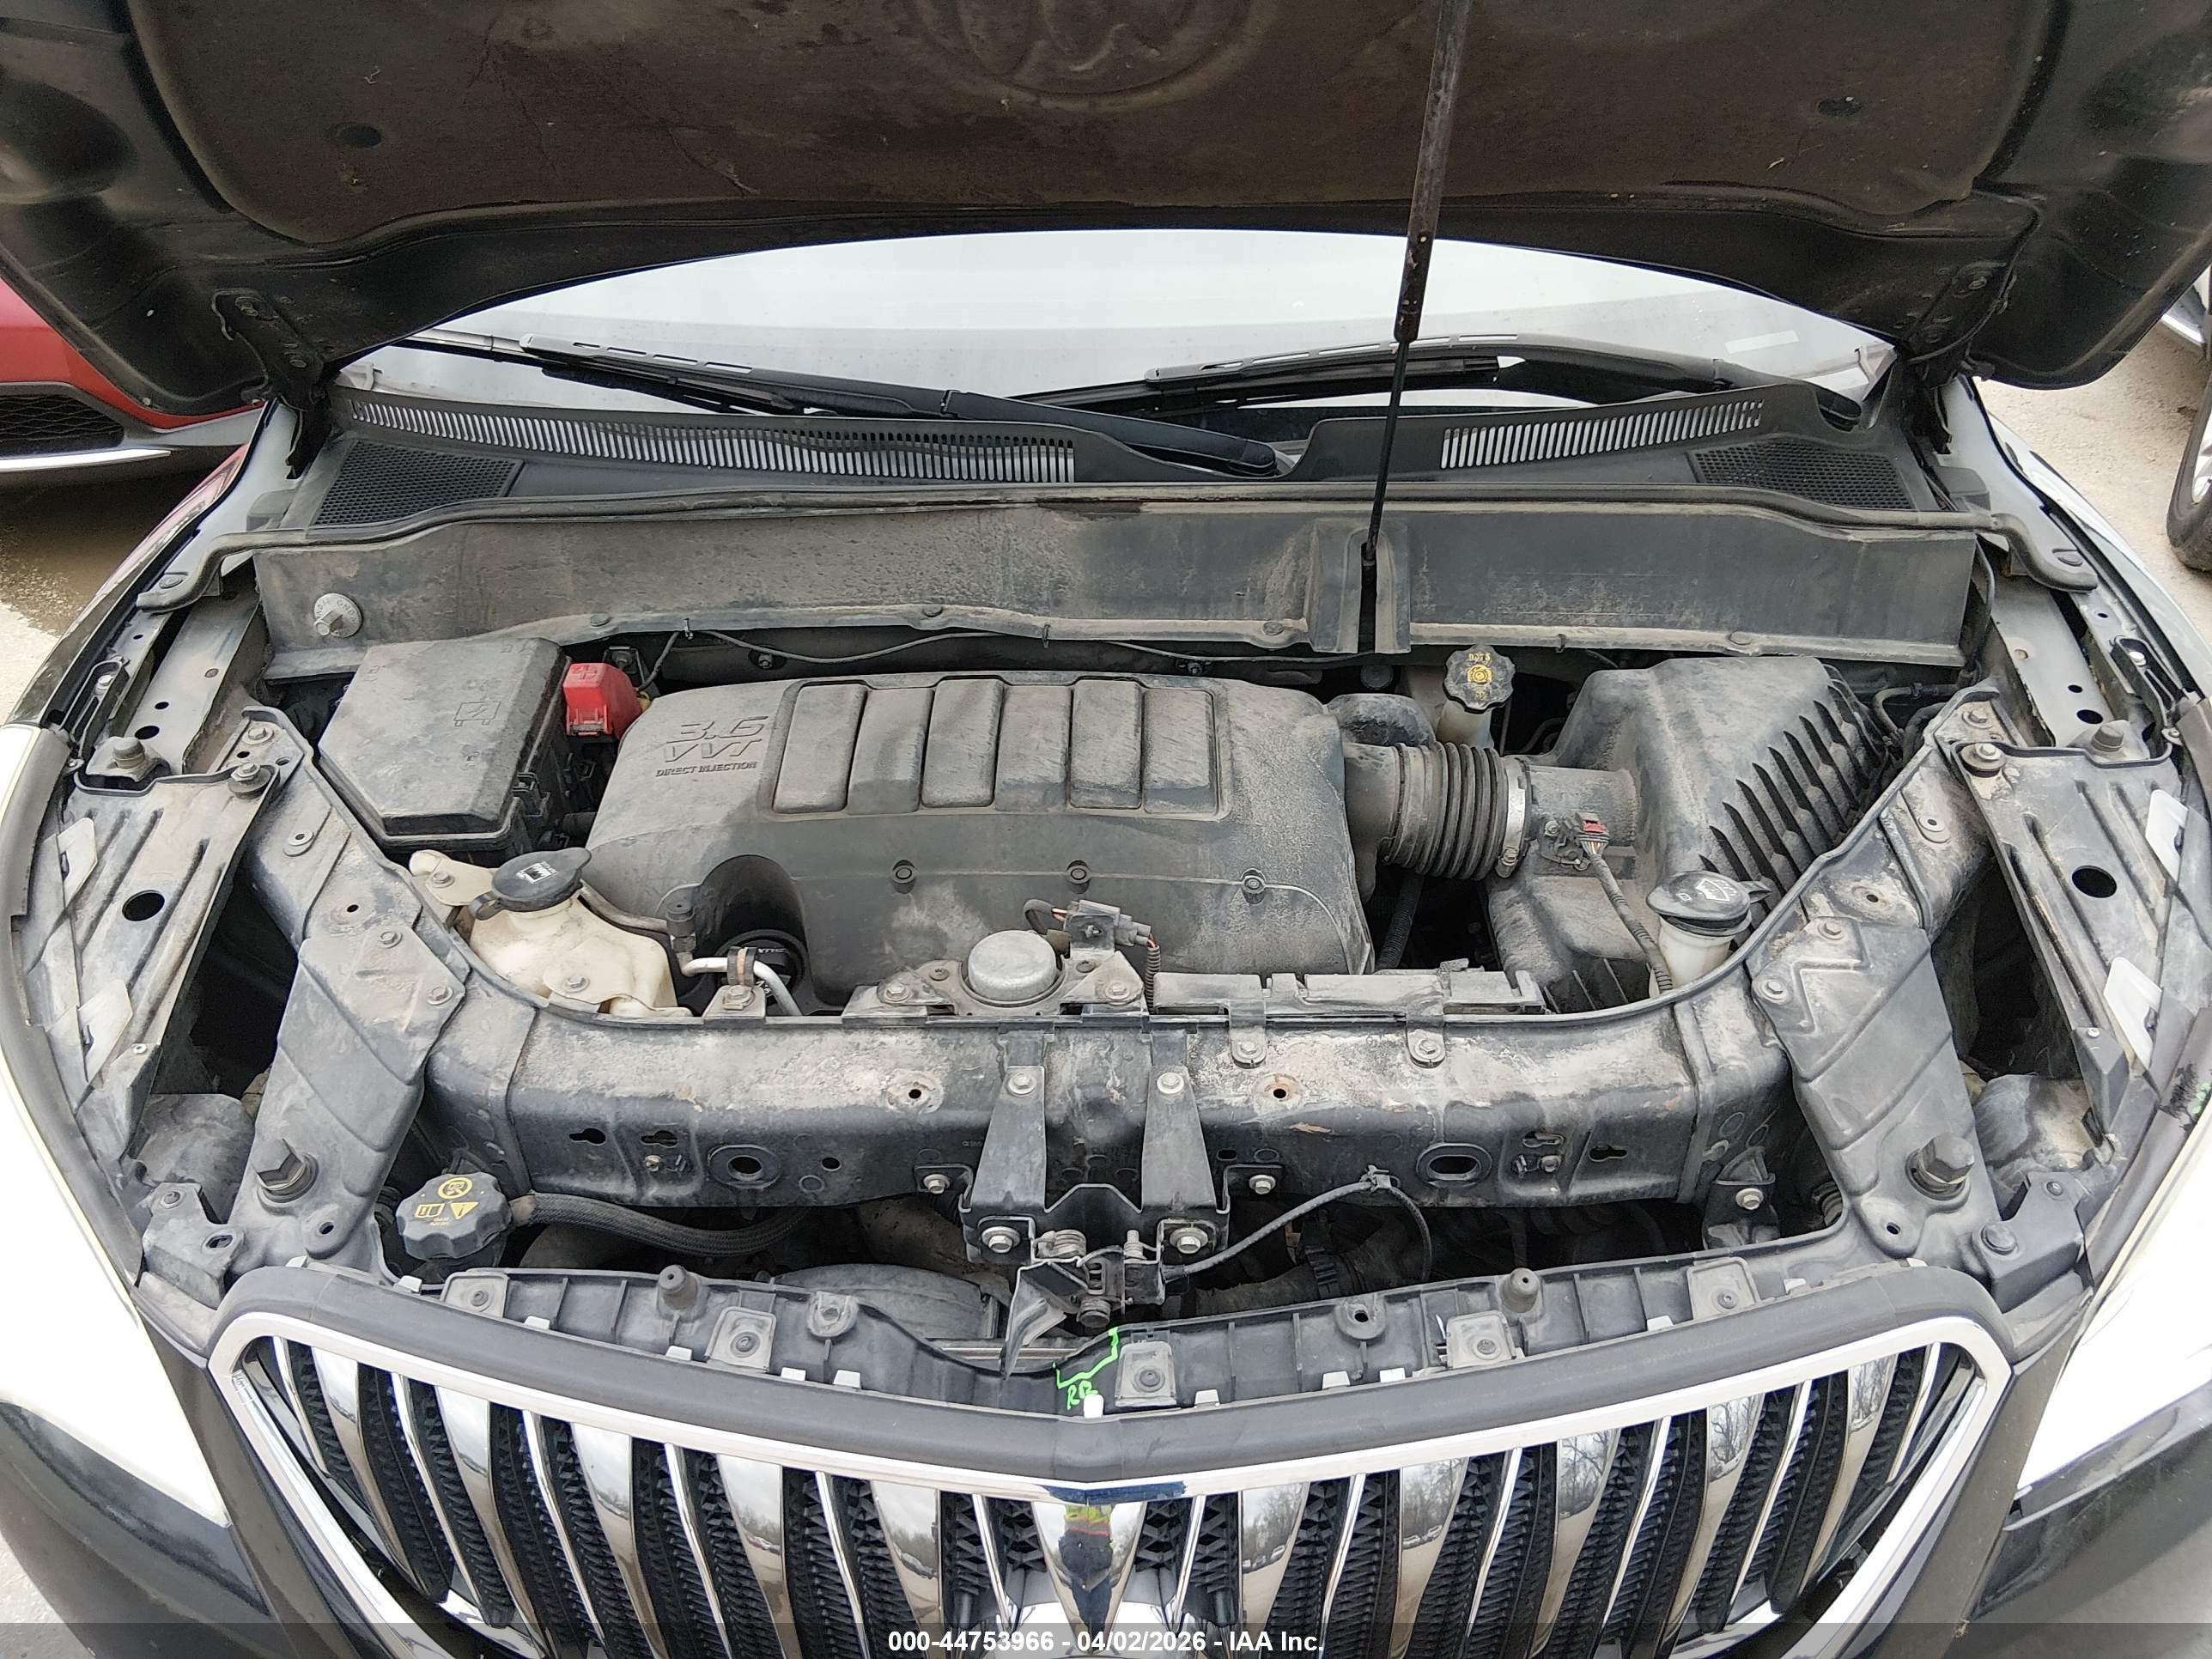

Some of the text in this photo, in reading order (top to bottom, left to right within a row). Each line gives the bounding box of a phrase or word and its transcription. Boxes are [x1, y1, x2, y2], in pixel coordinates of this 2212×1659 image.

[665, 716, 769, 744] 3.6
[664, 738, 763, 763] VVT
[655, 762, 757, 777] DIRECT INJECTION
